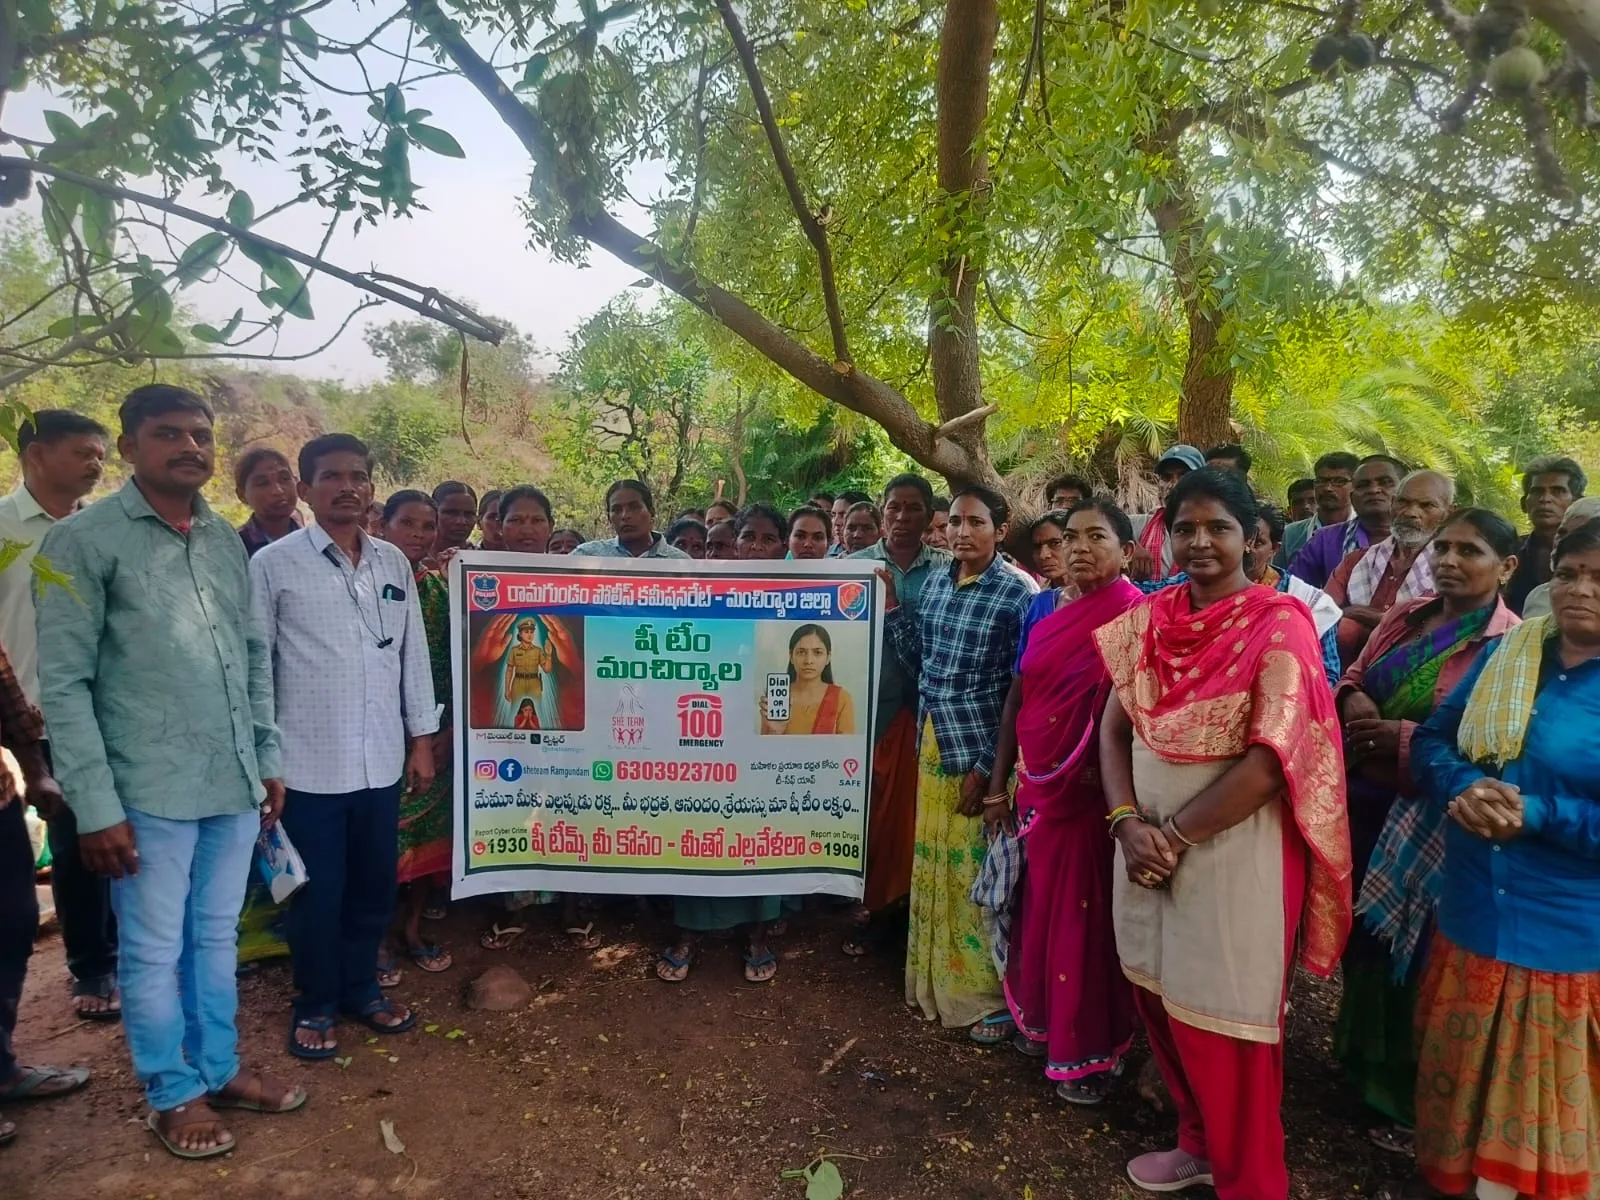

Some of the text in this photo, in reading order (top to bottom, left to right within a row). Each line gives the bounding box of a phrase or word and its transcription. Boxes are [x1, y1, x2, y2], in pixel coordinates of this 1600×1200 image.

[507, 583, 589, 604] రామగుండం
[593, 583, 634, 606] పోలీస్
[726, 588, 797, 617] మంచిర్యాల
[799, 591, 831, 616] జిల్లా
[635, 622, 711, 655] షీ టీం
[597, 656, 742, 691] మంచిర్యాల
[769, 678, 788, 687] Dial
[770, 689, 788, 697] 100
[691, 700, 709, 709] DIAL
[769, 709, 788, 718] 112
[612, 716, 645, 728] SHE TEAM
[677, 709, 722, 738] 100
[679, 738, 724, 748] EMERGENCY
[550, 766, 590, 778] Ramgundam
[616, 760, 738, 783] 6303923700
[839, 779, 862, 787] SAFE
[516, 789, 542, 809] మీకు
[622, 792, 638, 811] మీ
[768, 797, 788, 813] మా
[790, 792, 800, 815] షీ
[801, 791, 821, 813] టీం
[494, 828, 511, 836] Cyber
[810, 830, 831, 838] Report
[842, 831, 860, 841] Drugs
[487, 836, 528, 854] 1930
[531, 822, 546, 856] షీ
[592, 826, 612, 854] మీ
[616, 825, 662, 856] కోసం
[680, 827, 725, 858] మీతో
[824, 842, 859, 859] 1908
